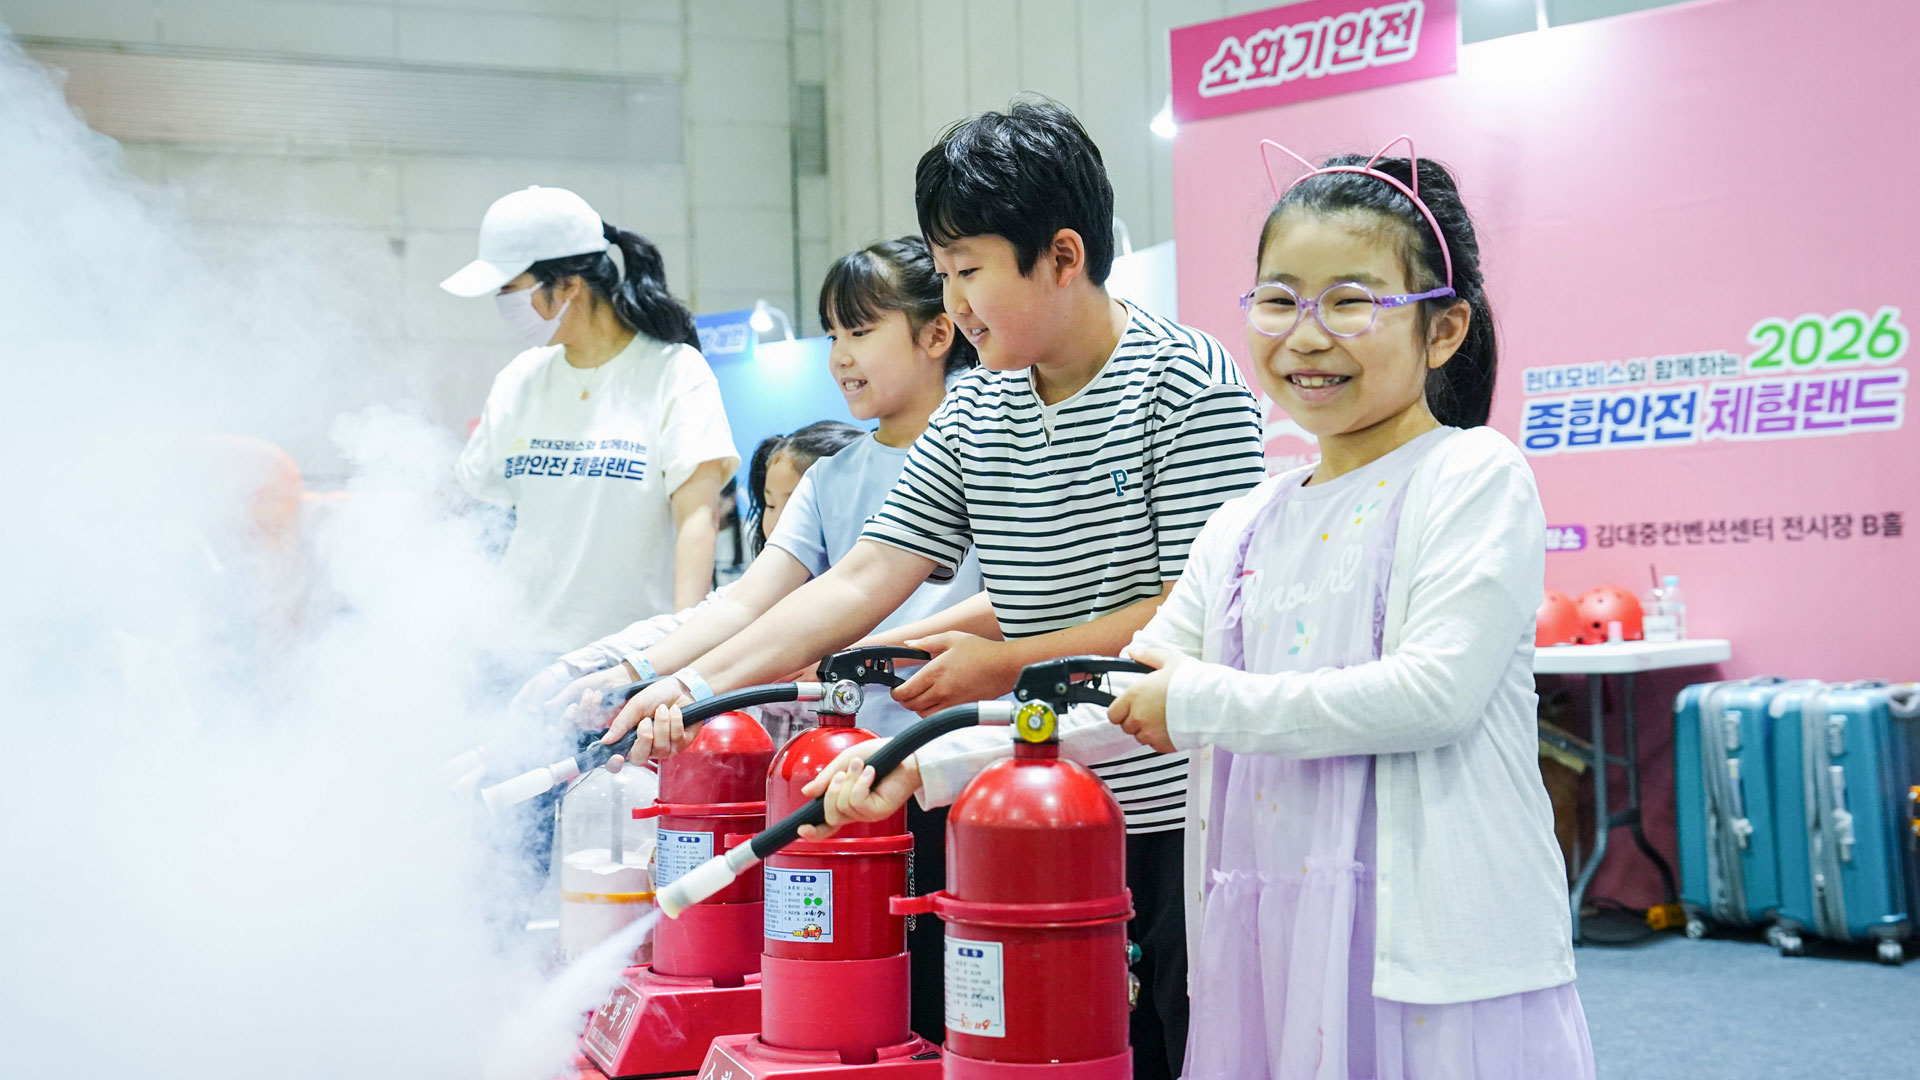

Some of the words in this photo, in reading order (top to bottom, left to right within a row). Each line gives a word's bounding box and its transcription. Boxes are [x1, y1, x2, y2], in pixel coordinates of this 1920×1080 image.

[1204, 6, 1417, 89] 소화기안전
[1526, 362, 1646, 391] 현대모비스와
[1655, 354, 1738, 380] 함께하는
[1750, 313, 1901, 369] 2026
[1524, 390, 1698, 450] 종합안전
[1705, 375, 1901, 434] 체험랜드
[570, 456, 647, 480] 체험랜드
[1111, 469, 1127, 496] P
[1595, 518, 1774, 548] 김대중컨벤션센터
[1782, 513, 1853, 541] 전시장
[1862, 511, 1904, 538] B홀
